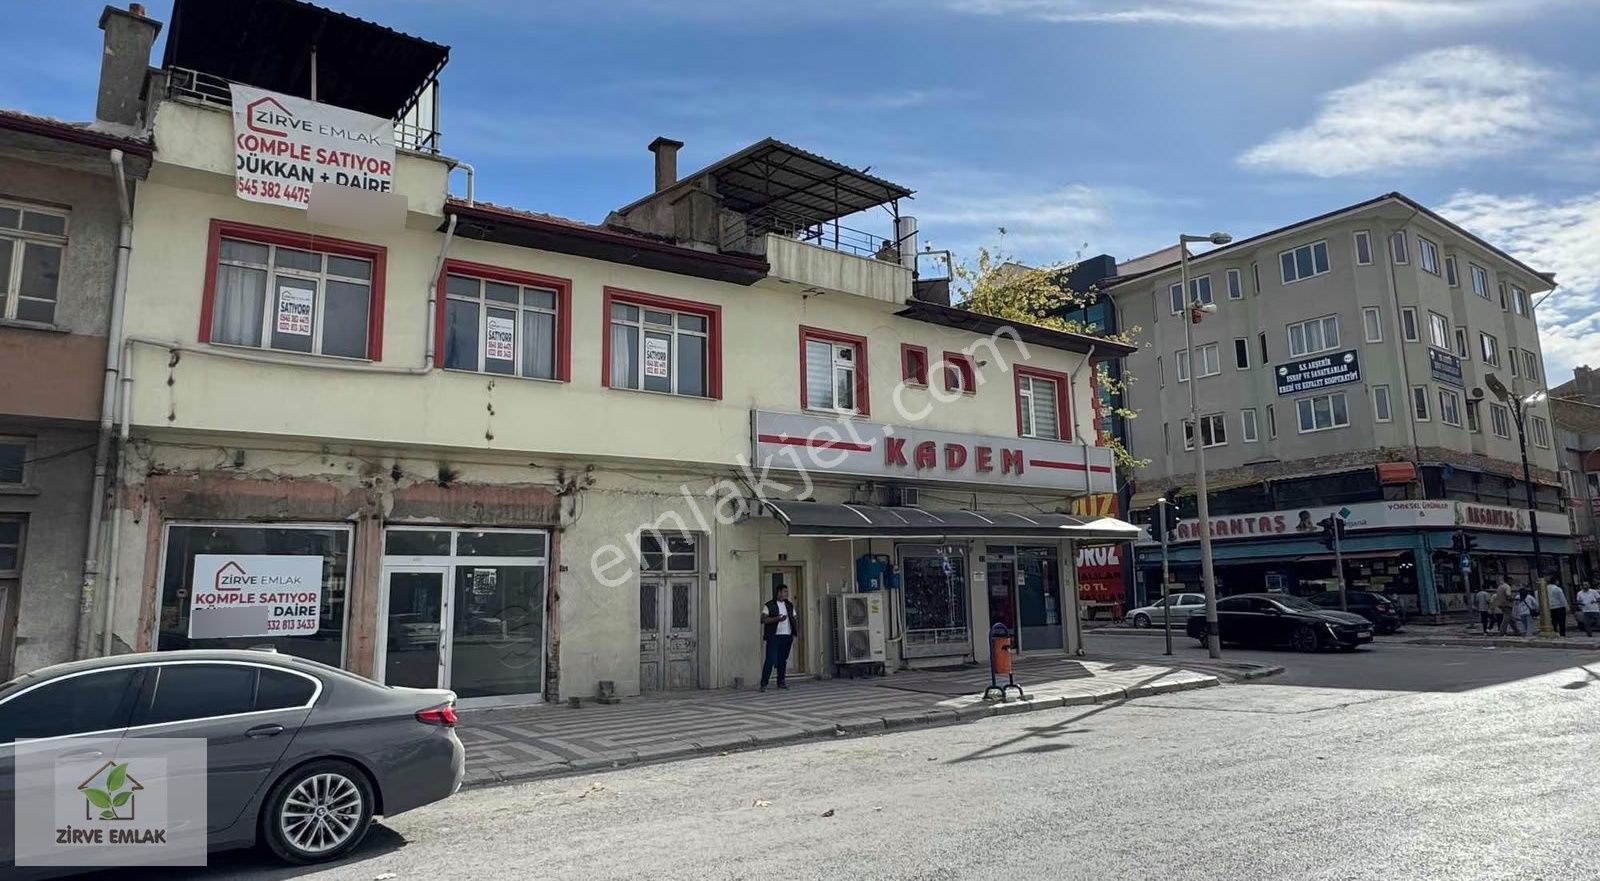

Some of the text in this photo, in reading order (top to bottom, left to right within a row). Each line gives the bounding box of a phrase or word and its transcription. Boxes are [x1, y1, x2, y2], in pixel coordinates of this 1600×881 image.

[256, 111, 382, 147] ZİRVE EMLAK
[237, 133, 391, 176] KOMPLE SATIYOR
[237, 153, 314, 183] DÜKKAN
[336, 171, 391, 194] DAİRE
[236, 177, 310, 203] 545 382 4475
[1303, 372, 1310, 380] VE
[1295, 383, 1302, 391] VE
[884, 437, 1024, 475] KADEM
[221, 574, 302, 585] ZİRVE EMLAK
[1093, 583, 1108, 592] TL
[195, 592, 317, 605] KOMPLE SATIYOR
[274, 603, 316, 616] DAİRE
[282, 619, 295, 630] 813
[297, 618, 315, 630] 3433
